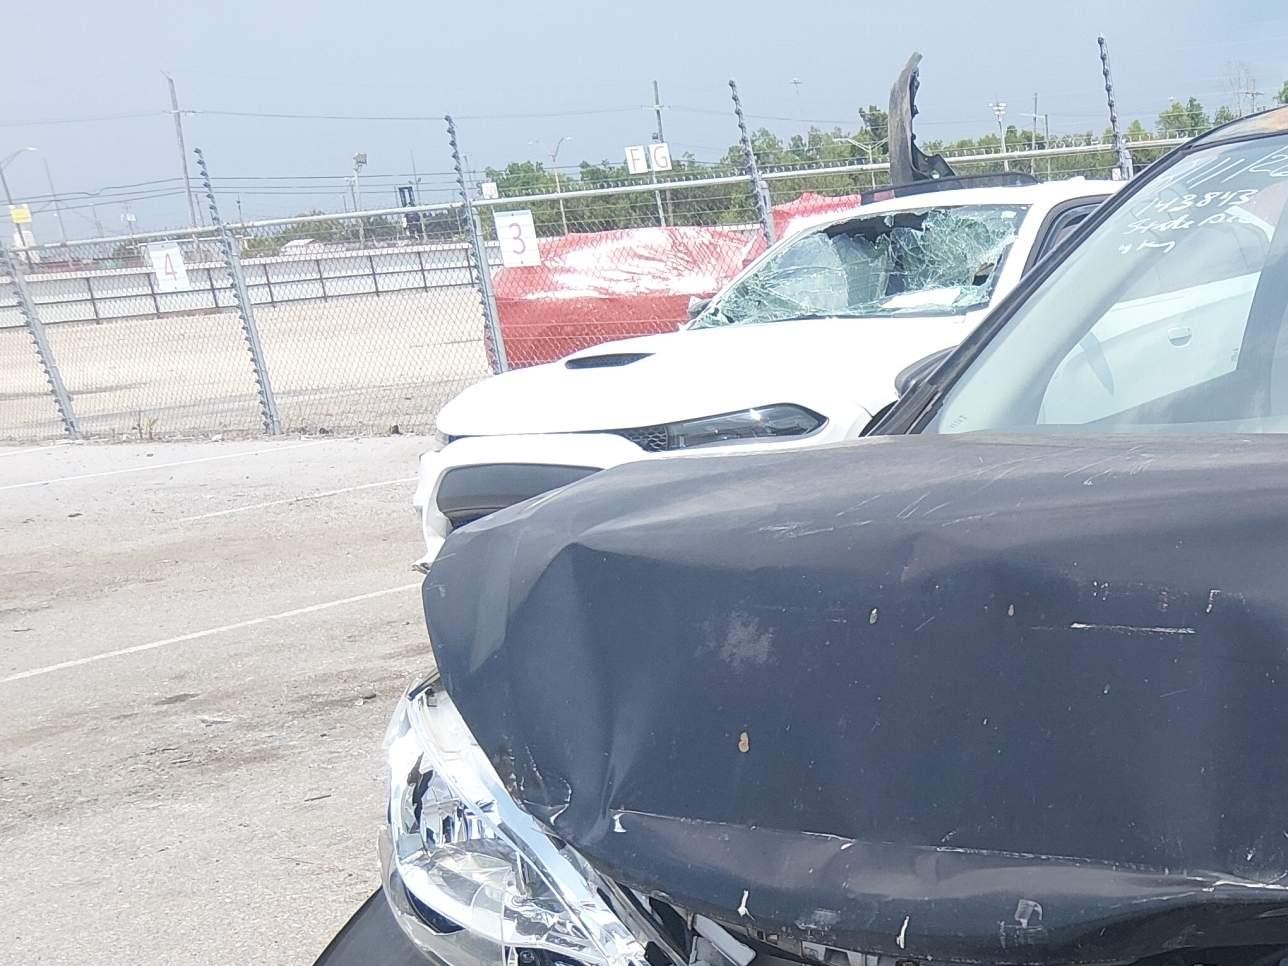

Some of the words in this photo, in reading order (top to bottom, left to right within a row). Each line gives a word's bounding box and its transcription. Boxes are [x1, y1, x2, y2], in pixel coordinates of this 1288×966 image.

[629, 148, 642, 171] F
[653, 145, 668, 169] G
[509, 222, 526, 255] 3
[164, 252, 178, 281] 4
